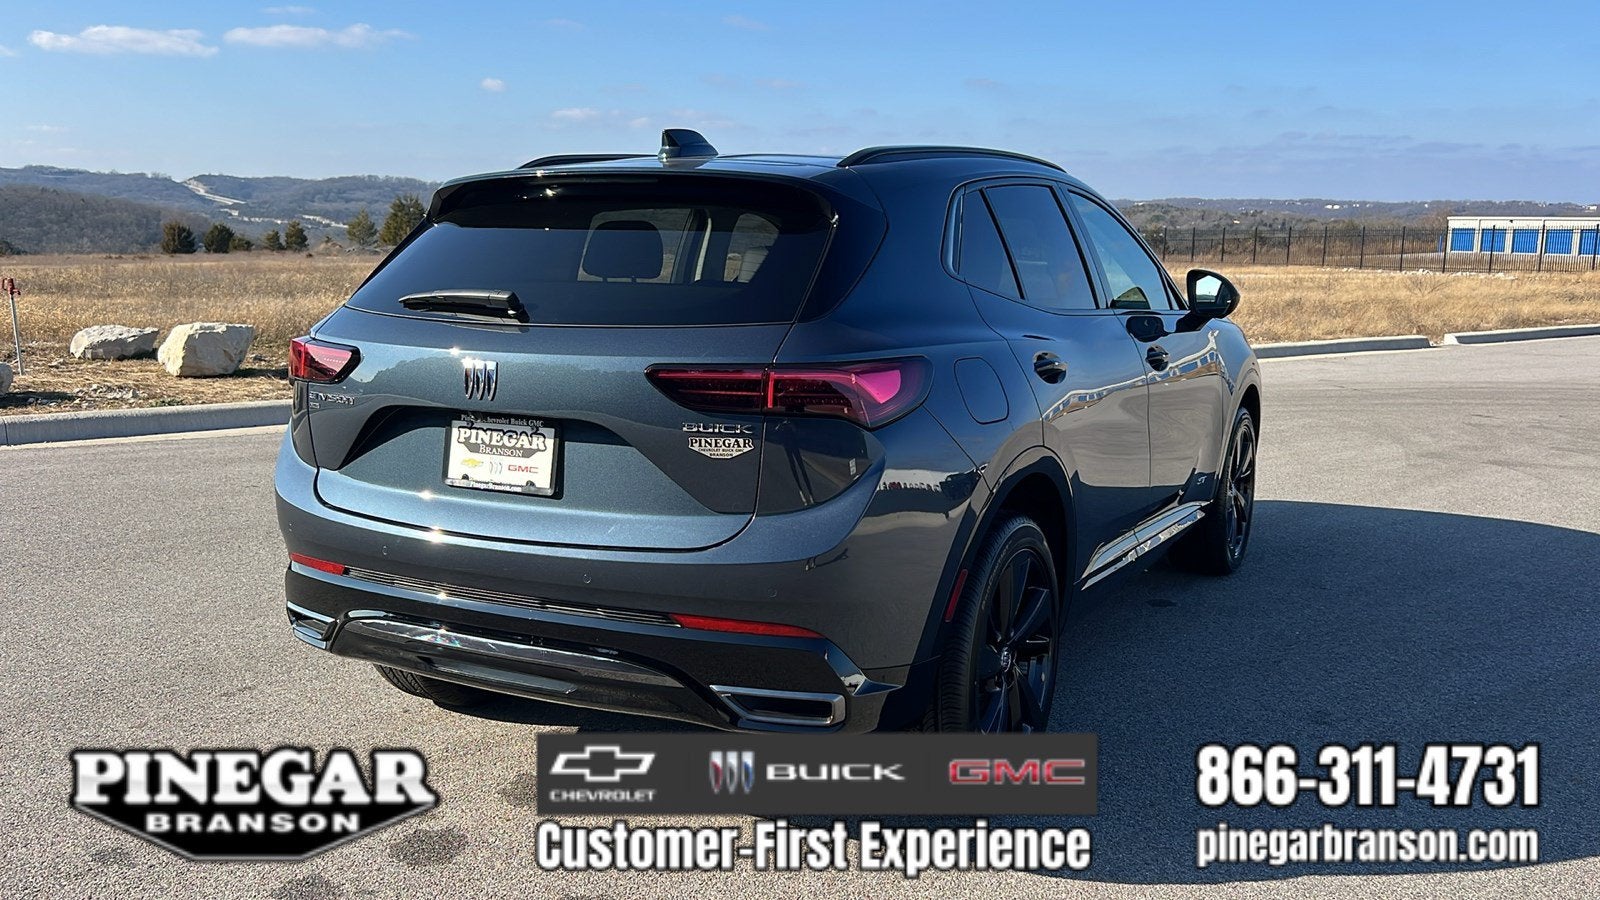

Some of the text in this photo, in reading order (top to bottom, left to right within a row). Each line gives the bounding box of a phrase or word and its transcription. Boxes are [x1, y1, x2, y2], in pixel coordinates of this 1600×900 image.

[529, 419, 545, 428] GMC
[682, 422, 753, 434] BUICK
[457, 428, 547, 451] PINEGAR
[690, 438, 752, 448] PINEGAR
[478, 444, 524, 458] BRANSON
[507, 464, 539, 474] GMC
